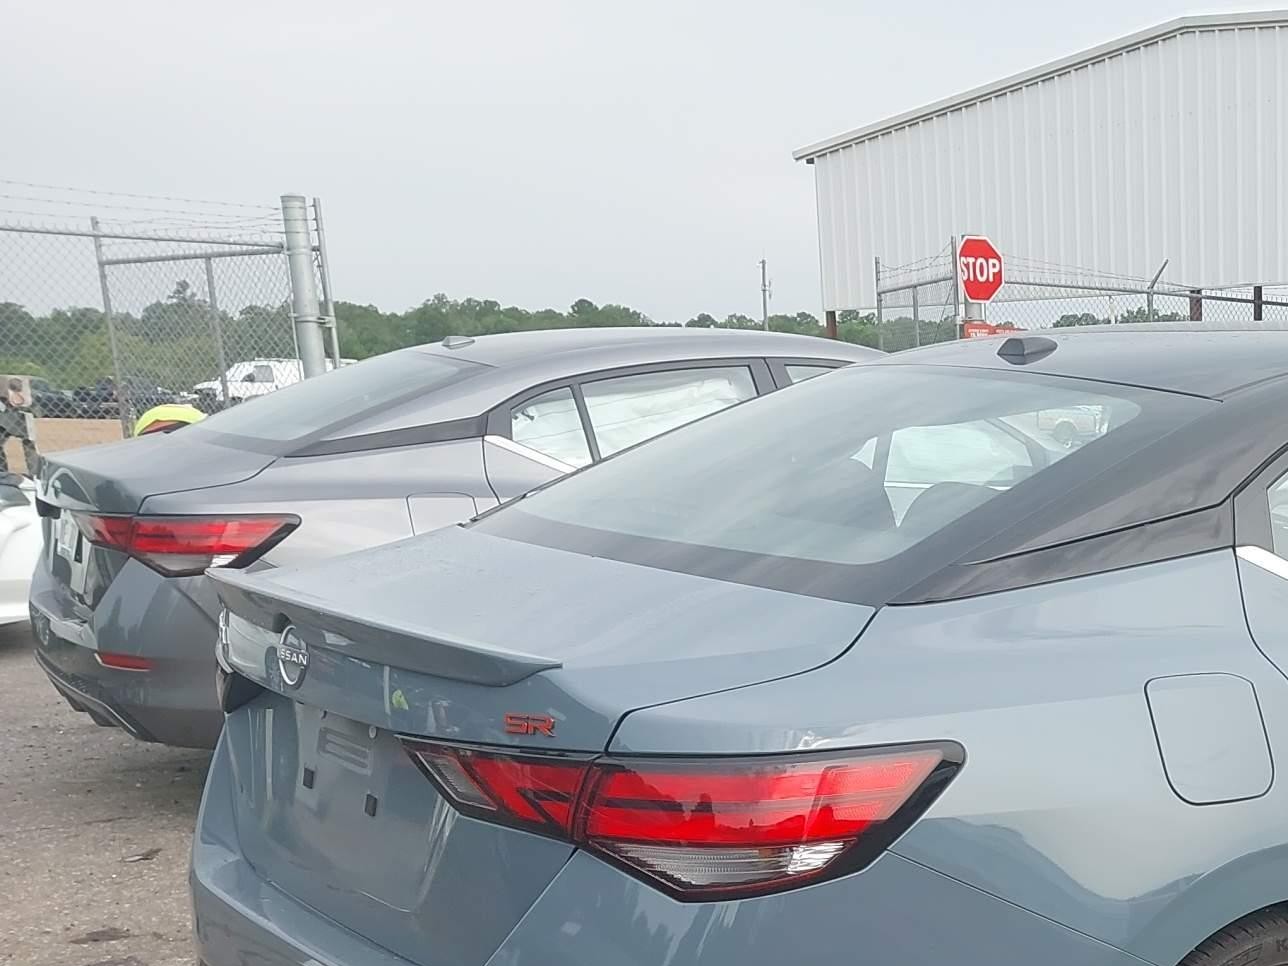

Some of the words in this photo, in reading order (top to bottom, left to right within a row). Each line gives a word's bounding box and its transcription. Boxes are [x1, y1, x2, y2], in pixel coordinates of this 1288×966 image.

[960, 256, 1000, 282] STOP
[278, 647, 308, 665] SSAN
[504, 712, 556, 737] SR
